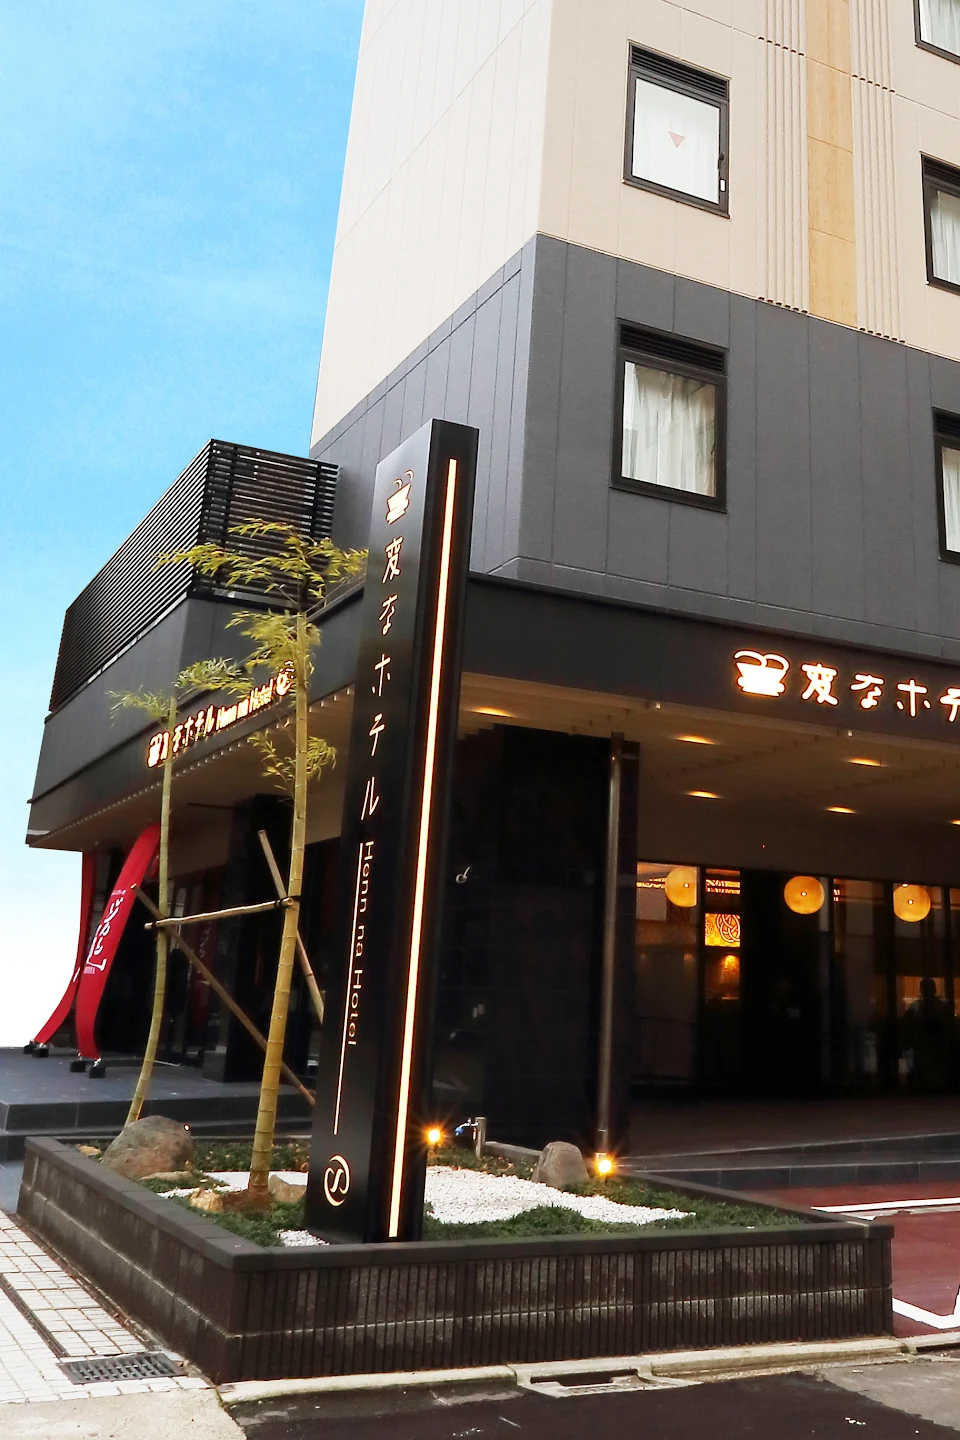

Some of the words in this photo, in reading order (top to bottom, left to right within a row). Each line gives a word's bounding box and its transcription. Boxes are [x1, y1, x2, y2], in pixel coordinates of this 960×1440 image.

[361, 536, 403, 821] 変なホテル
[359, 841, 375, 913] Henn
[355, 925, 365, 957] na
[347, 969, 363, 1045] Hotel
